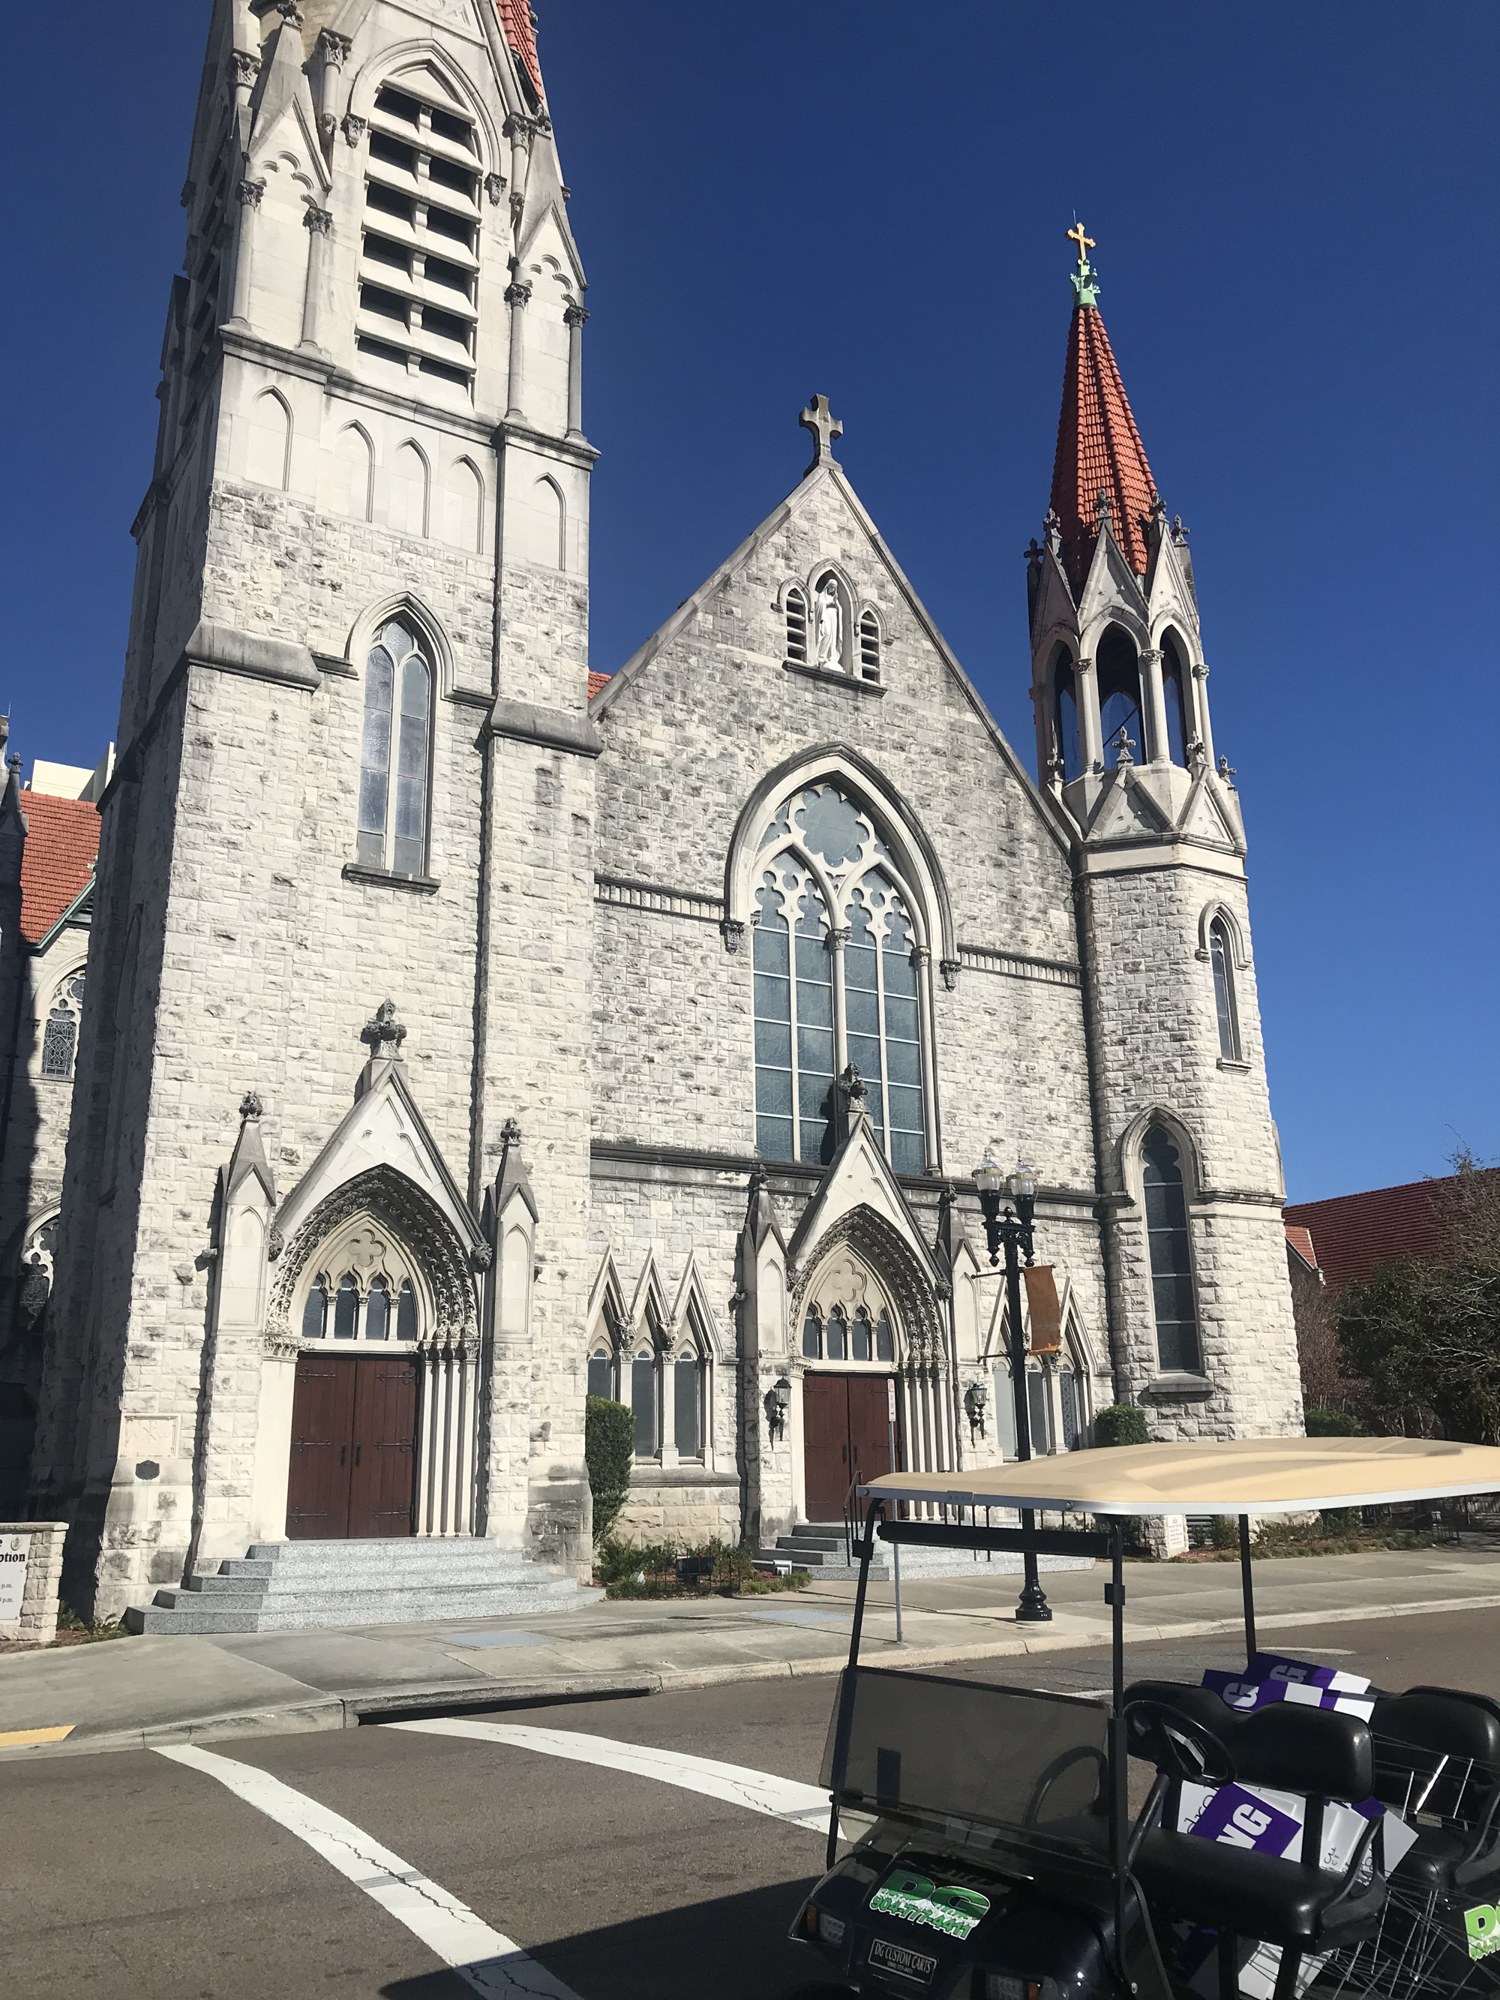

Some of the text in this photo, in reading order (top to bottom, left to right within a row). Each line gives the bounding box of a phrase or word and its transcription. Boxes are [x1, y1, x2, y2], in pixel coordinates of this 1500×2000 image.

[876, 1868, 991, 1921] DG
[885, 1946, 912, 1967] CUSTOM
[911, 1955, 933, 1974] CARTS
